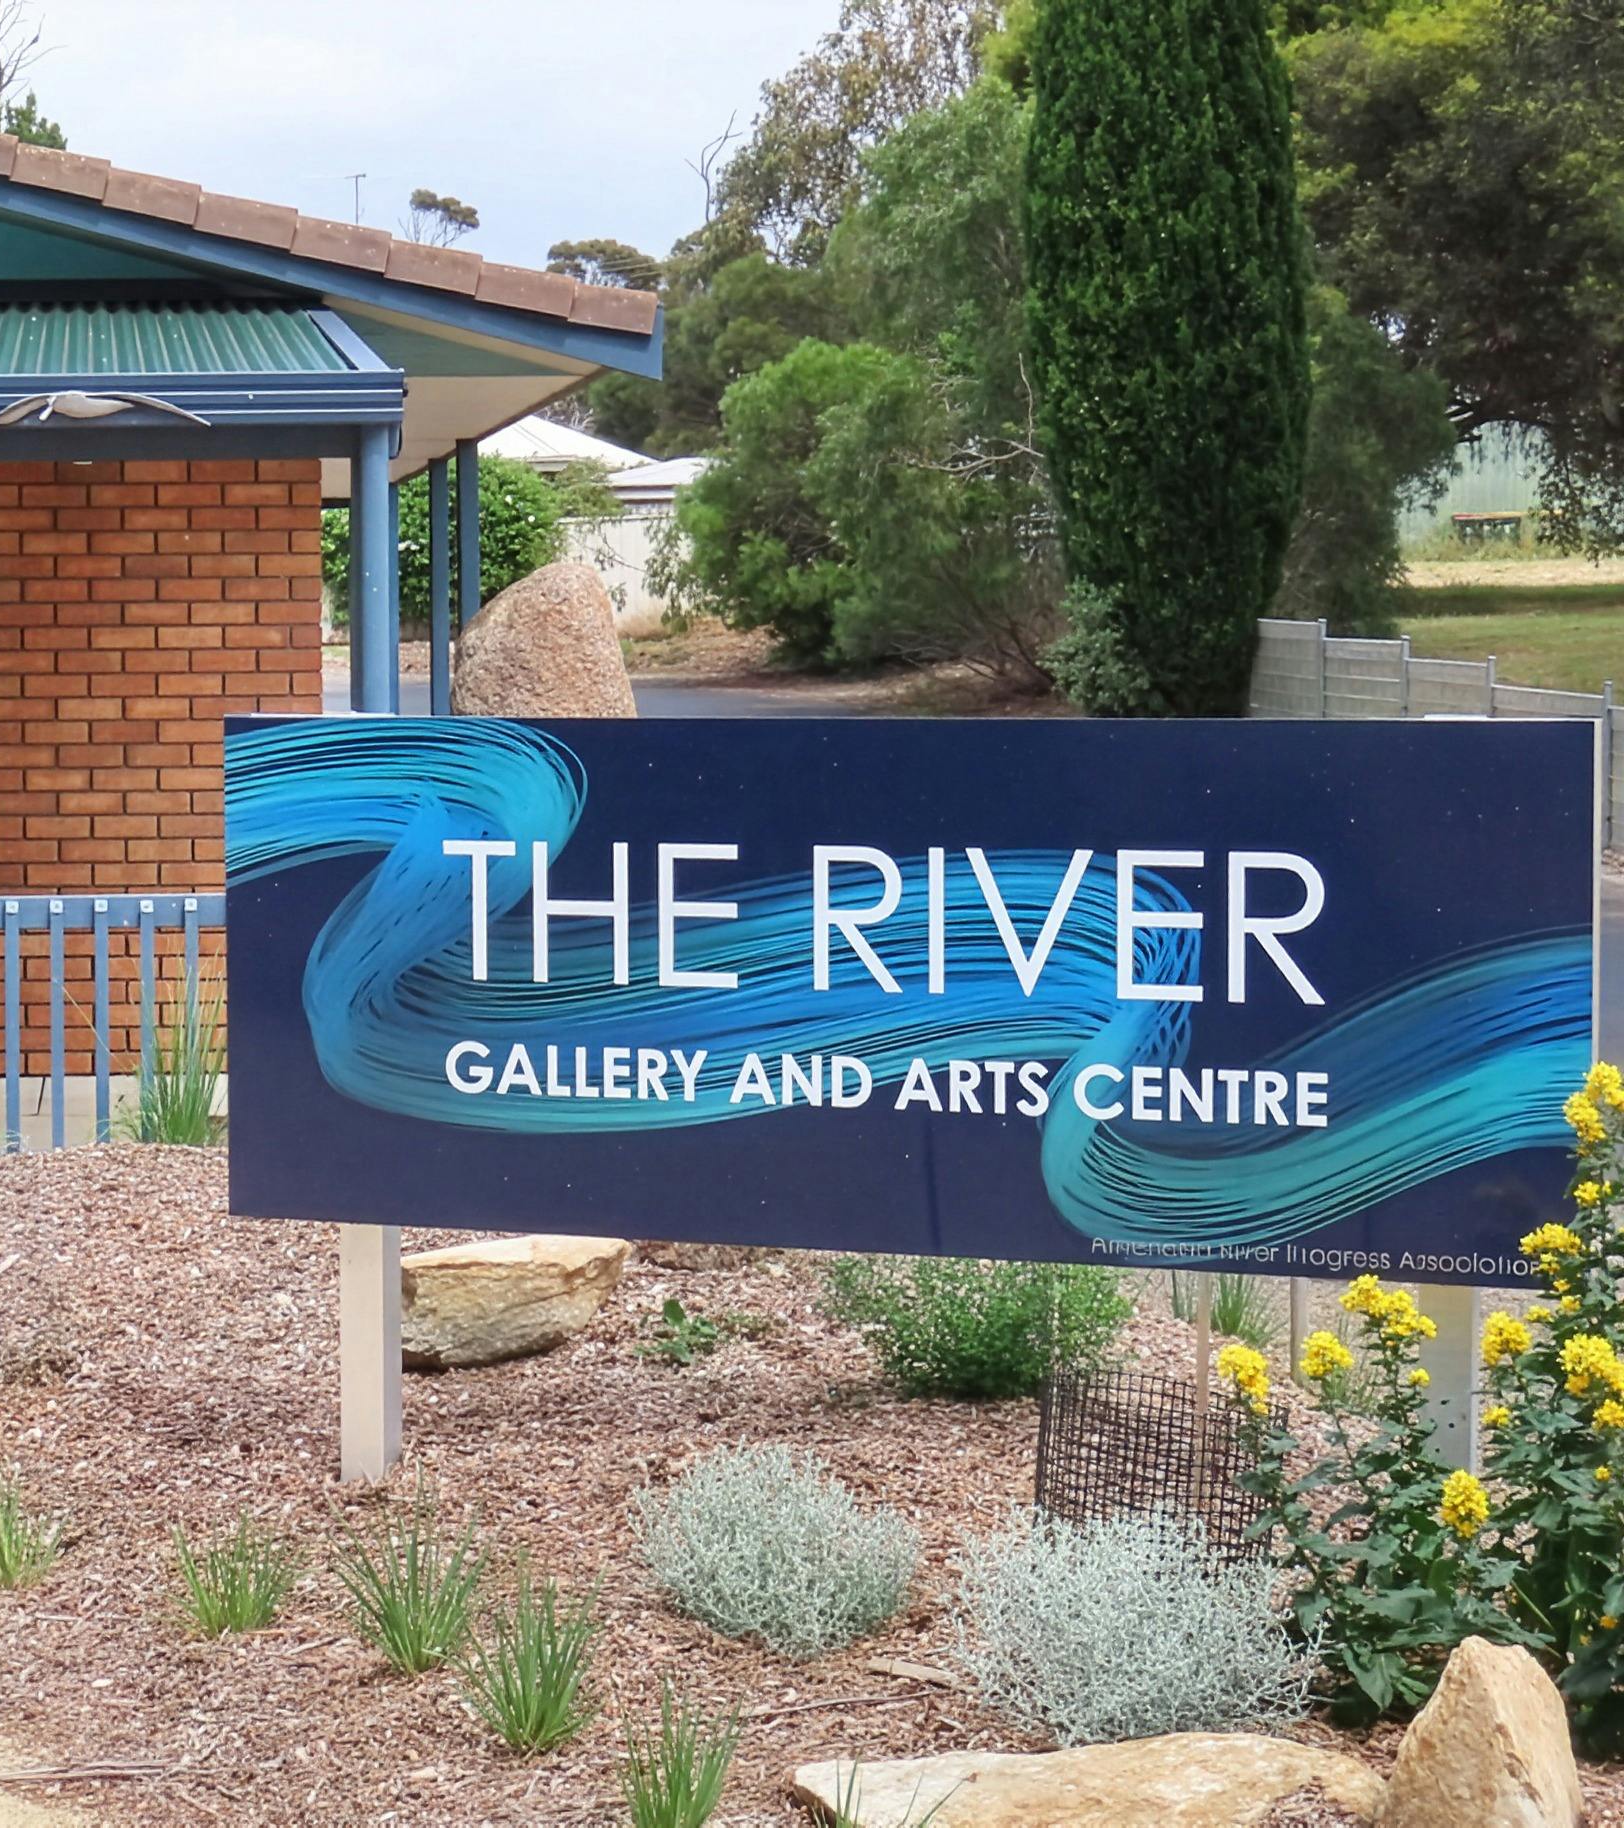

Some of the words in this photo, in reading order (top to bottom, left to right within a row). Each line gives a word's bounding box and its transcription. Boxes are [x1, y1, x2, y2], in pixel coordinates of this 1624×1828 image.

[442, 840, 739, 988] THE
[812, 844, 1326, 1006] RIVER
[444, 1040, 709, 1103] GALLERY
[728, 1052, 874, 1109] AND
[894, 1058, 1050, 1118] ARTS
[1072, 1063, 1329, 1128] CENTRE
